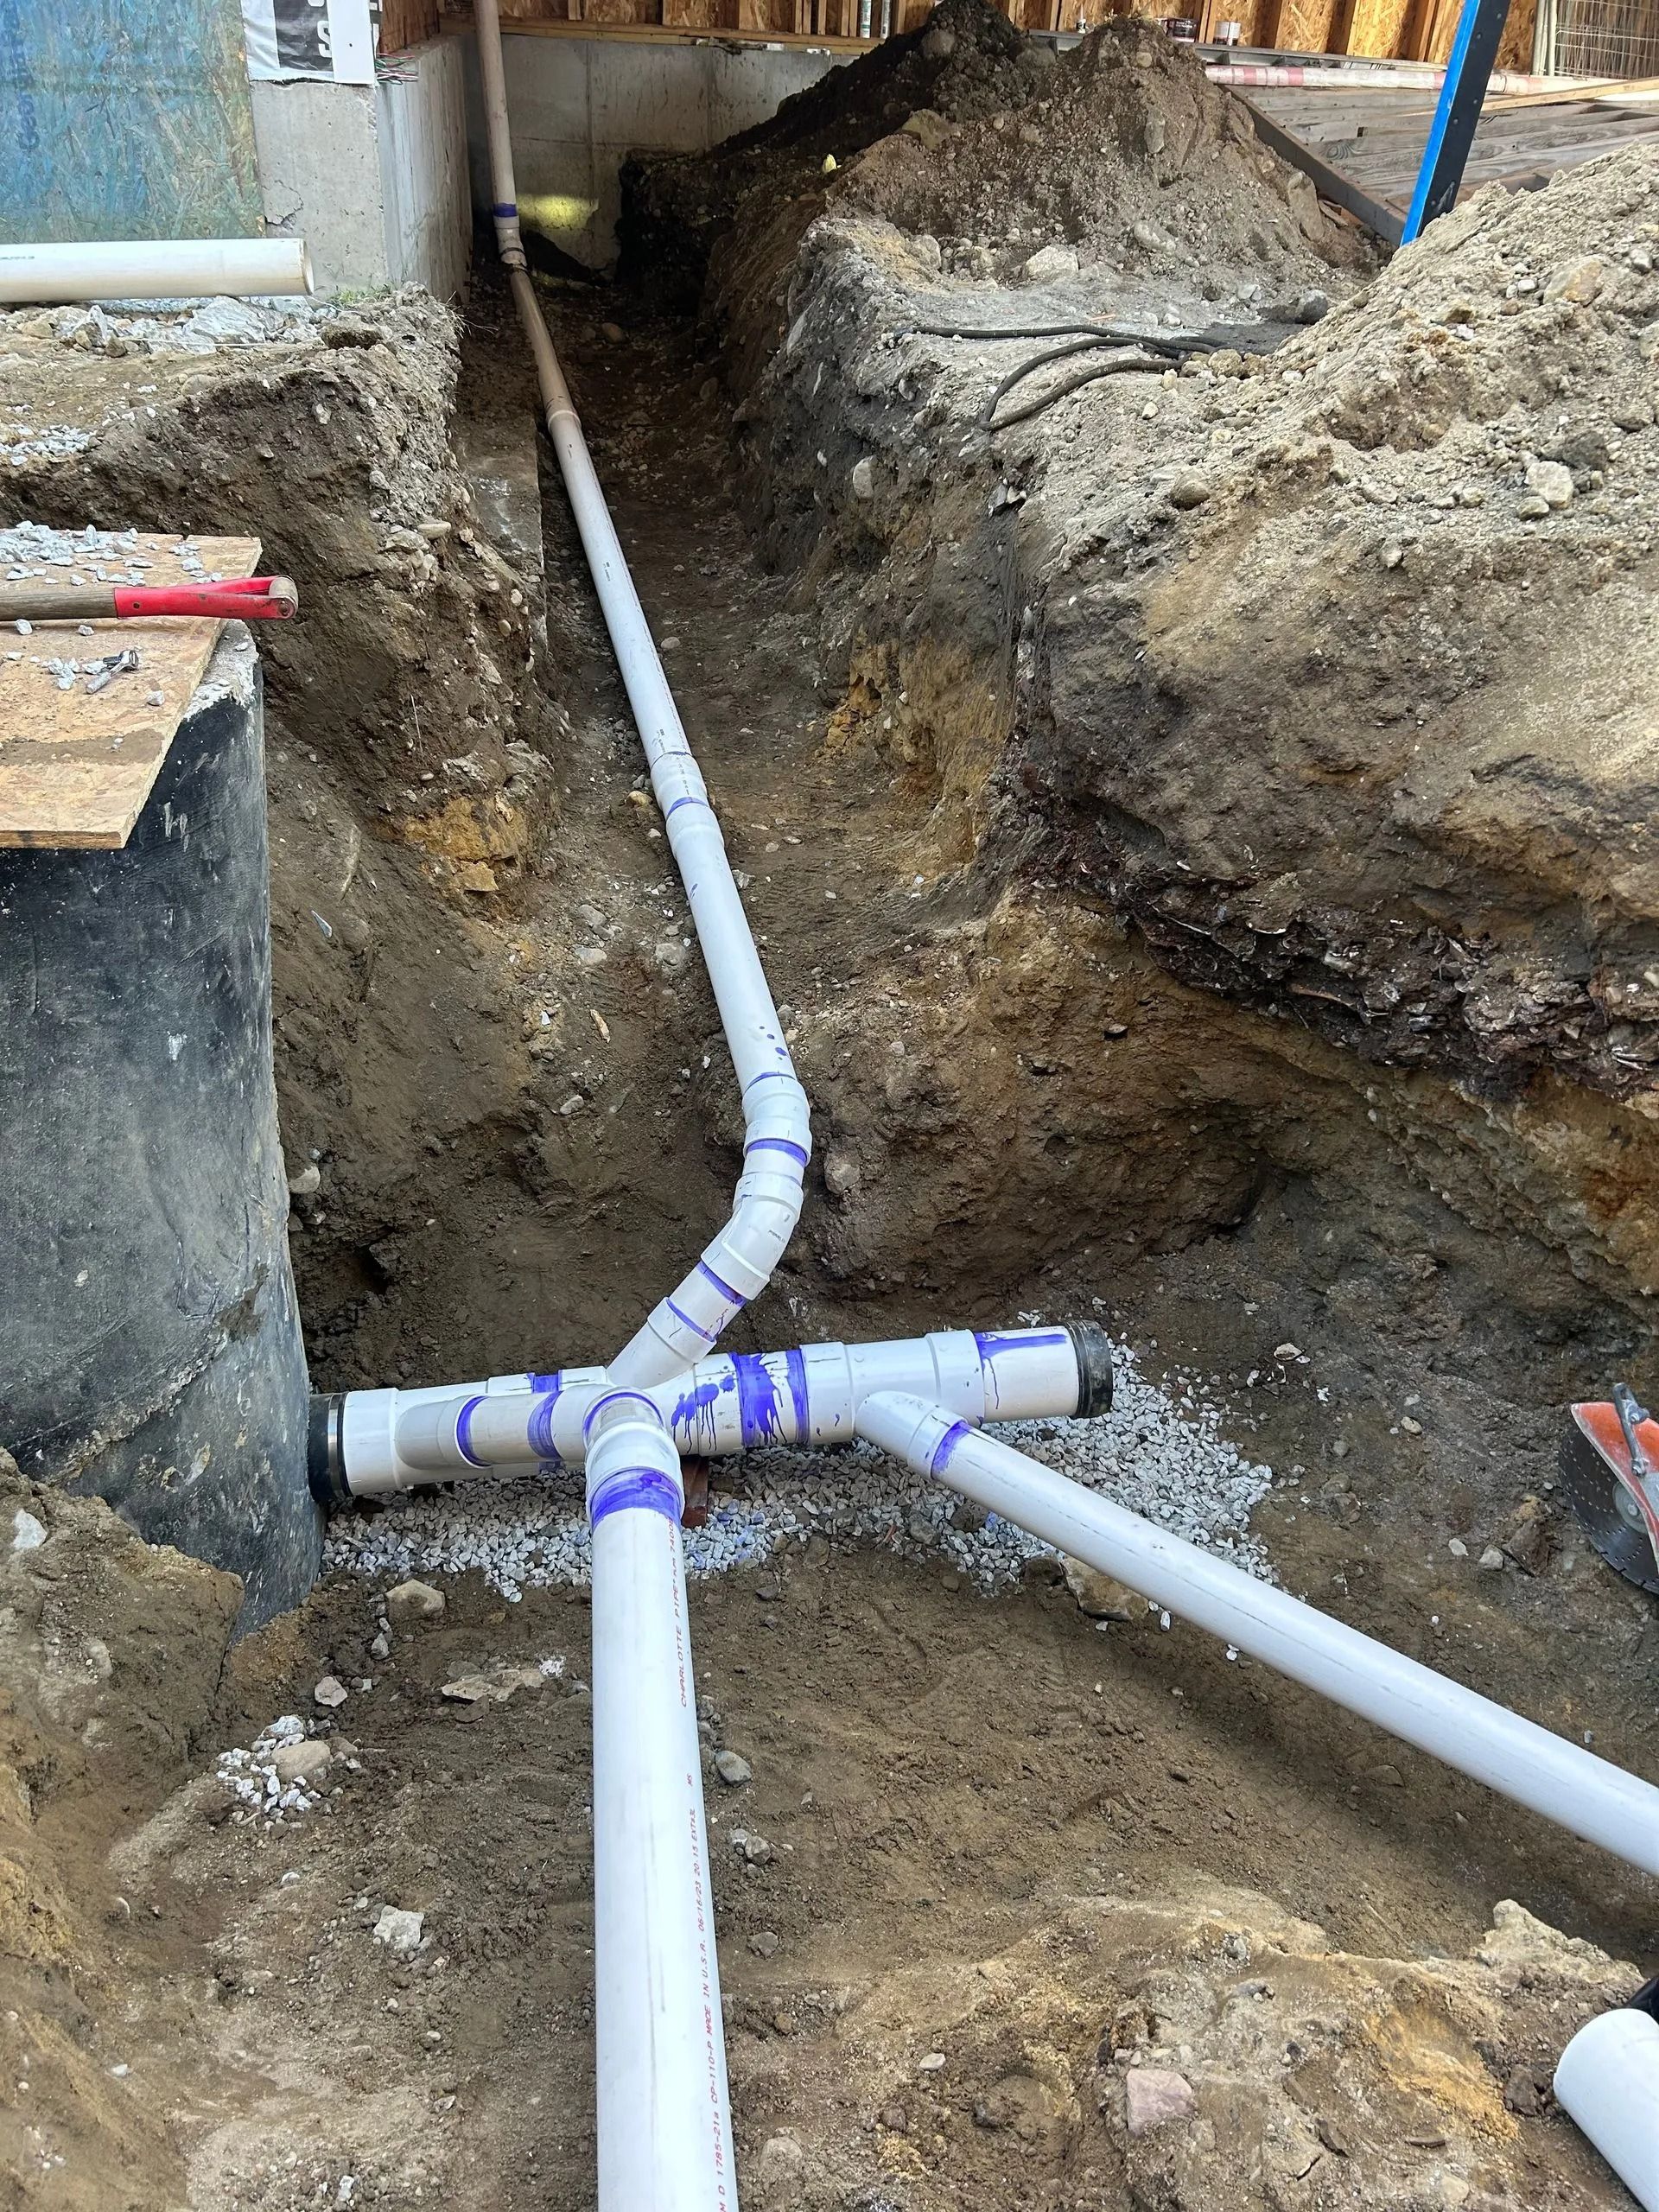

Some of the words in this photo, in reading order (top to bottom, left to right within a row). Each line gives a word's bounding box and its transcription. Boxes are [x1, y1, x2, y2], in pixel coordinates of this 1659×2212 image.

[677, 1625, 687, 1707] CHARLOTTE
[702, 1983, 709, 1998] IN
[704, 2005, 713, 2036] MADE
[707, 2040, 719, 2104] CP-110-P
[718, 2185, 726, 2196] D
